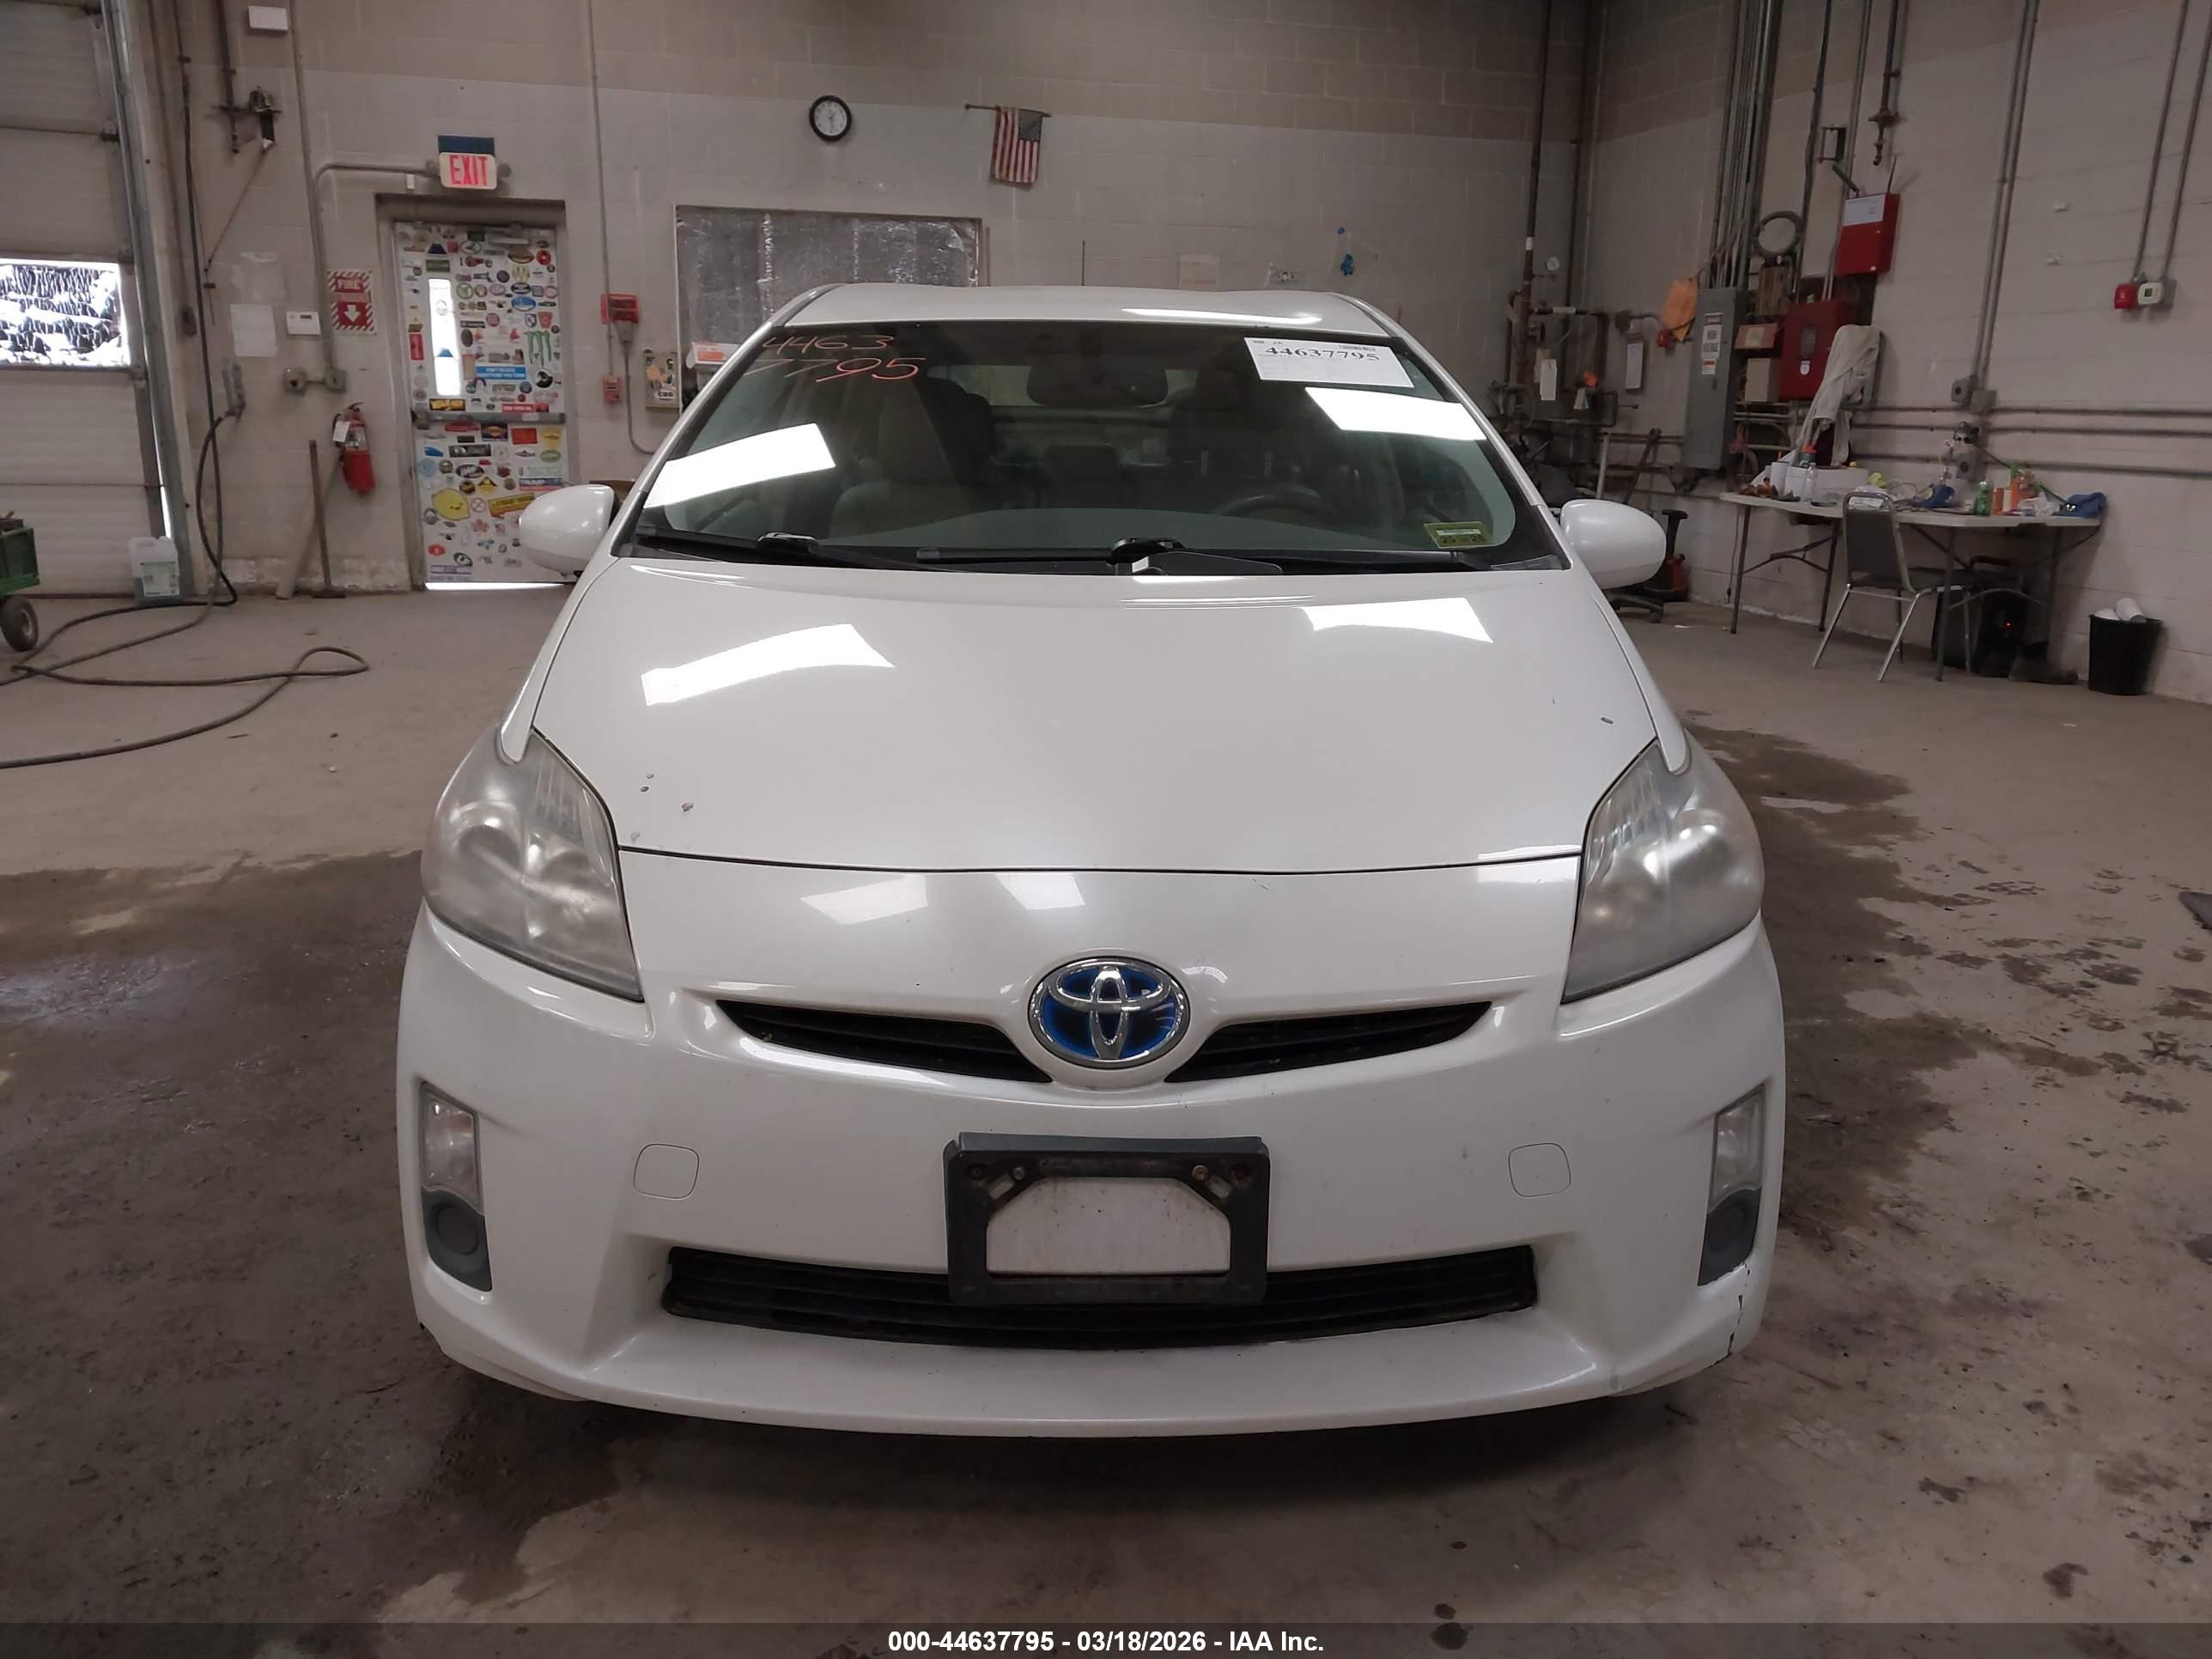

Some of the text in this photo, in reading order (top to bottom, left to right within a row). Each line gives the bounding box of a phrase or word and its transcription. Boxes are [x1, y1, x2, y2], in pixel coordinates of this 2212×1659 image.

[448, 155, 489, 186] EXIT
[337, 278, 364, 290] FIRE
[762, 334, 894, 356] 4463
[1265, 346, 1380, 362] 44637795
[744, 356, 927, 383] 7795
